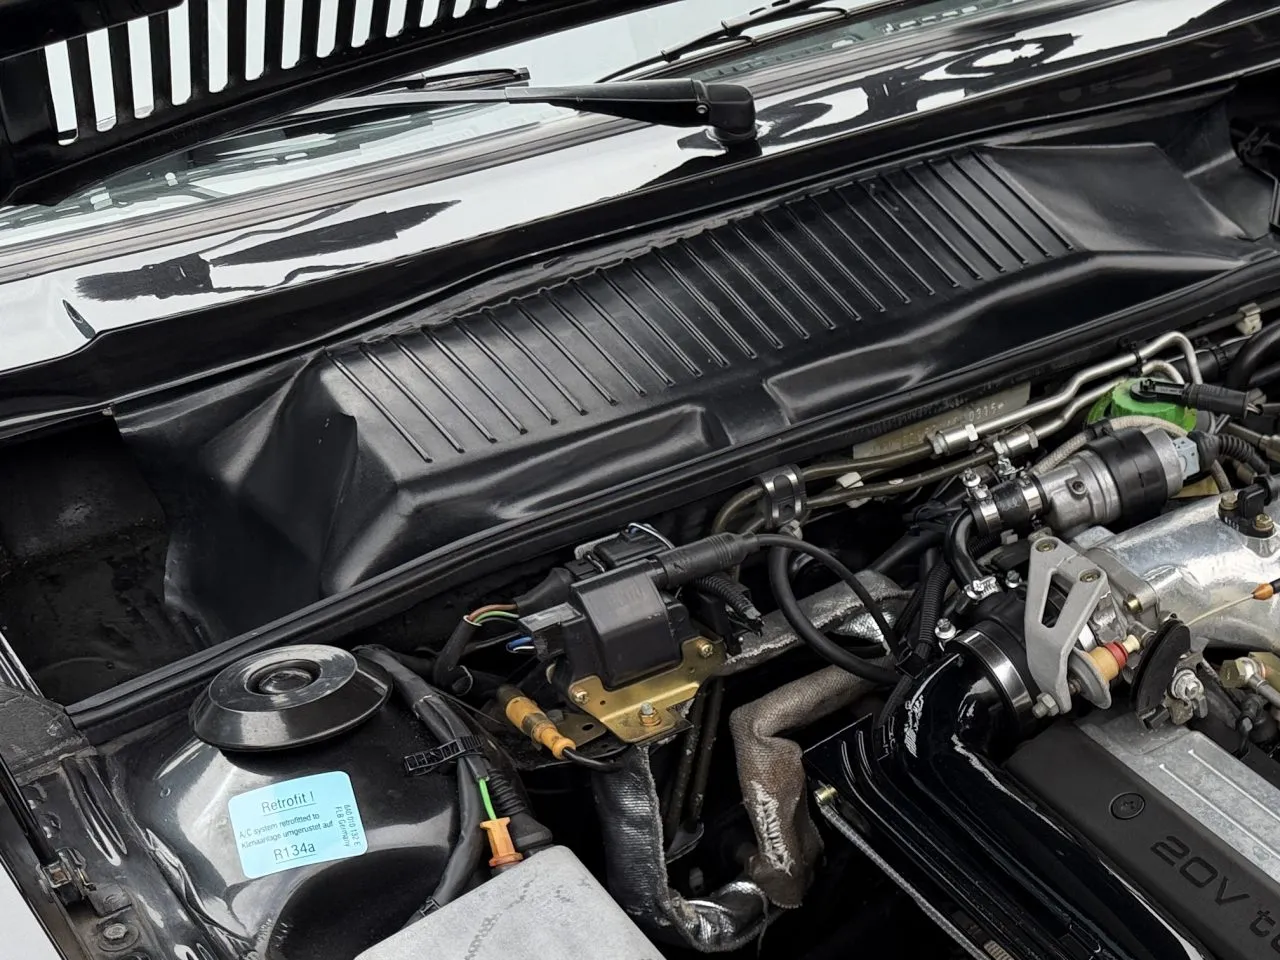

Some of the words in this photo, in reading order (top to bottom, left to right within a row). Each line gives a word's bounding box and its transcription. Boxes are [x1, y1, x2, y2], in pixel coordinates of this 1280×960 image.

[261, 792, 307, 813] Retrofit
[254, 823, 278, 836] system
[279, 815, 312, 828] retrofitted
[339, 819, 350, 847] Germany
[273, 841, 316, 861] R134a
[1150, 835, 1250, 906] 20V
